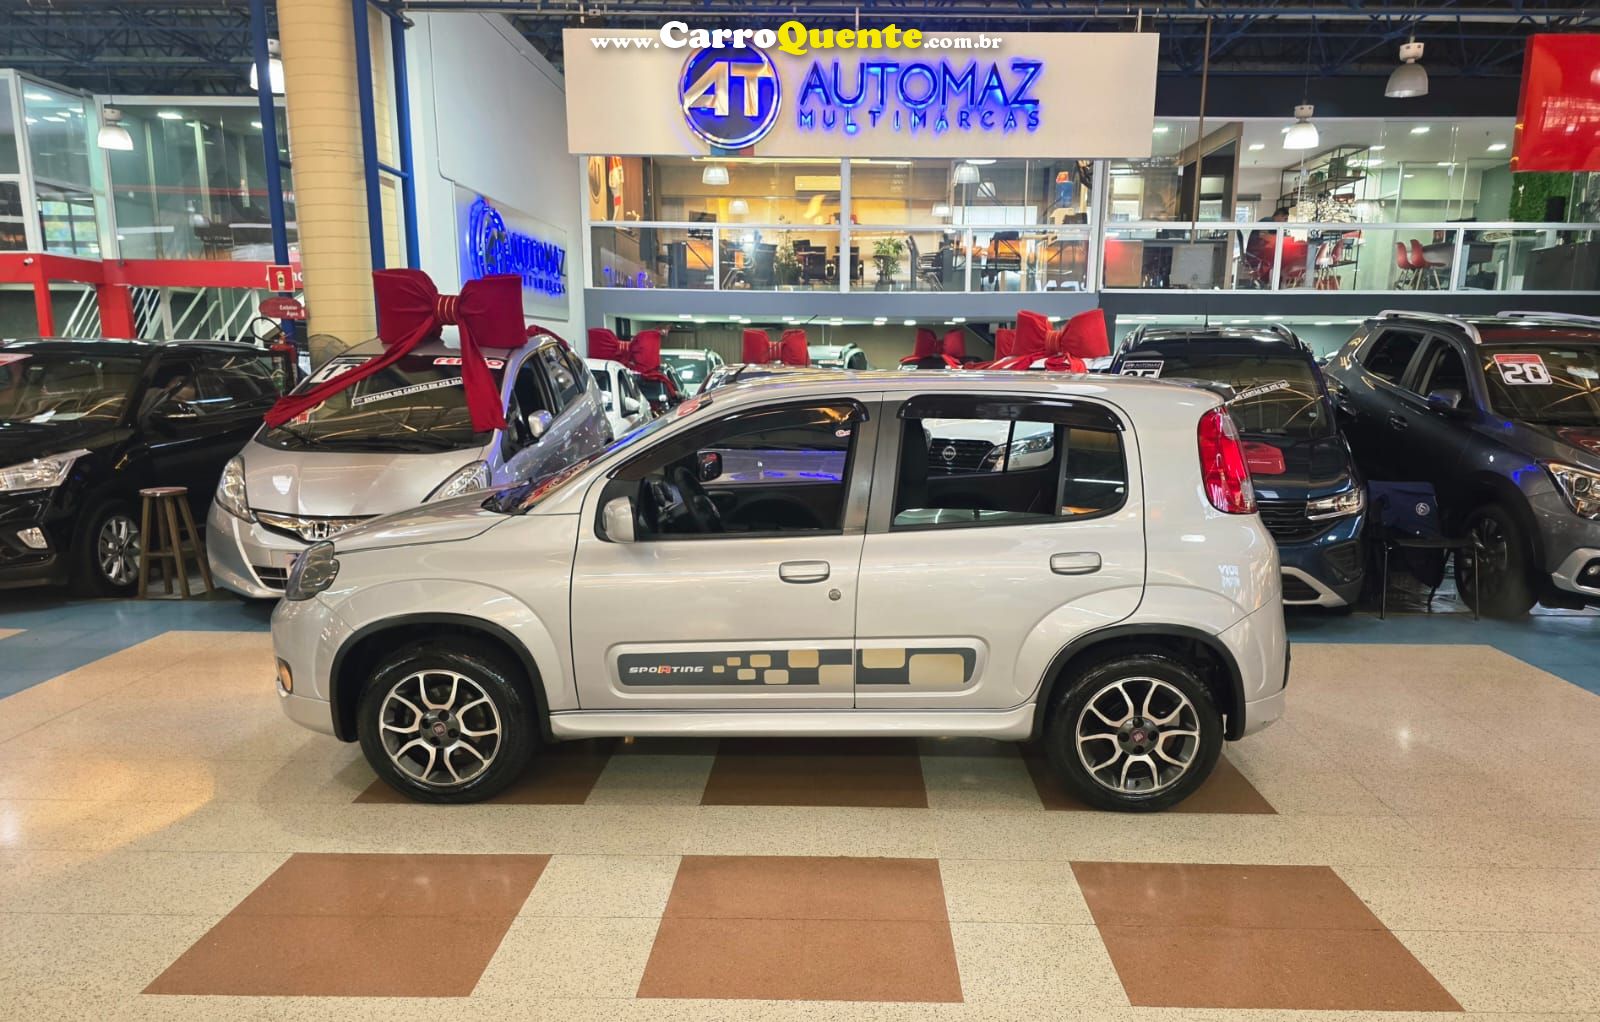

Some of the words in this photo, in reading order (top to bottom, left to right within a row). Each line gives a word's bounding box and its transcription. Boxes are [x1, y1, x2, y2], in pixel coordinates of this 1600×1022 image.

[799, 60, 1043, 107] AUTOMAZ
[799, 109, 1041, 129] MULTIMARCAS
[1503, 363, 1549, 383] 20
[628, 665, 704, 674] SPORTING
